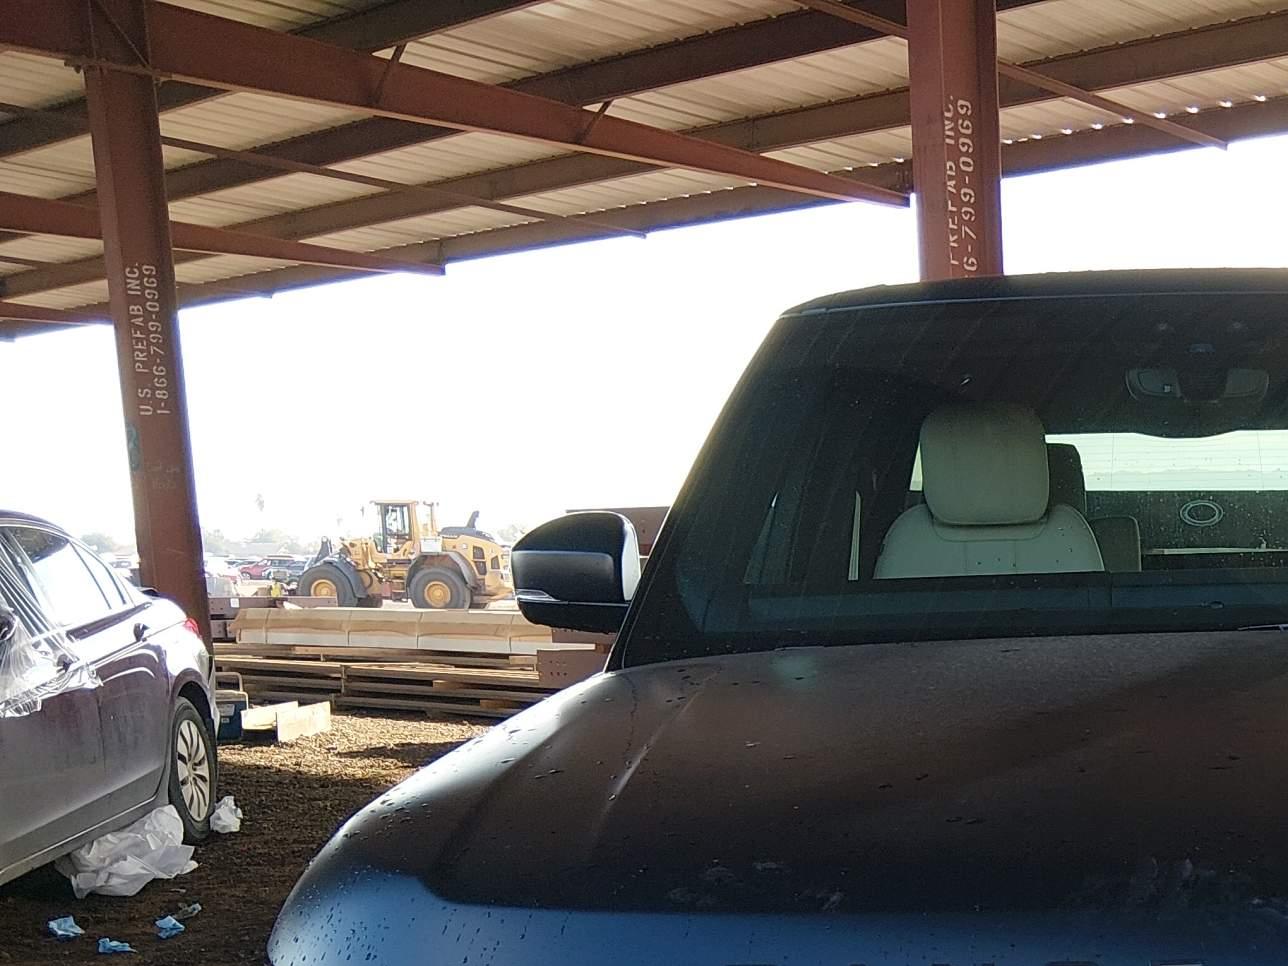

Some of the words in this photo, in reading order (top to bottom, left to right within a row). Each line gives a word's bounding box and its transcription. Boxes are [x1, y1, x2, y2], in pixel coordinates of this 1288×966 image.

[125, 262, 142, 295] INC.
[129, 304, 149, 372] PREFAB
[143, 265, 171, 415] 1-866-799-0969
